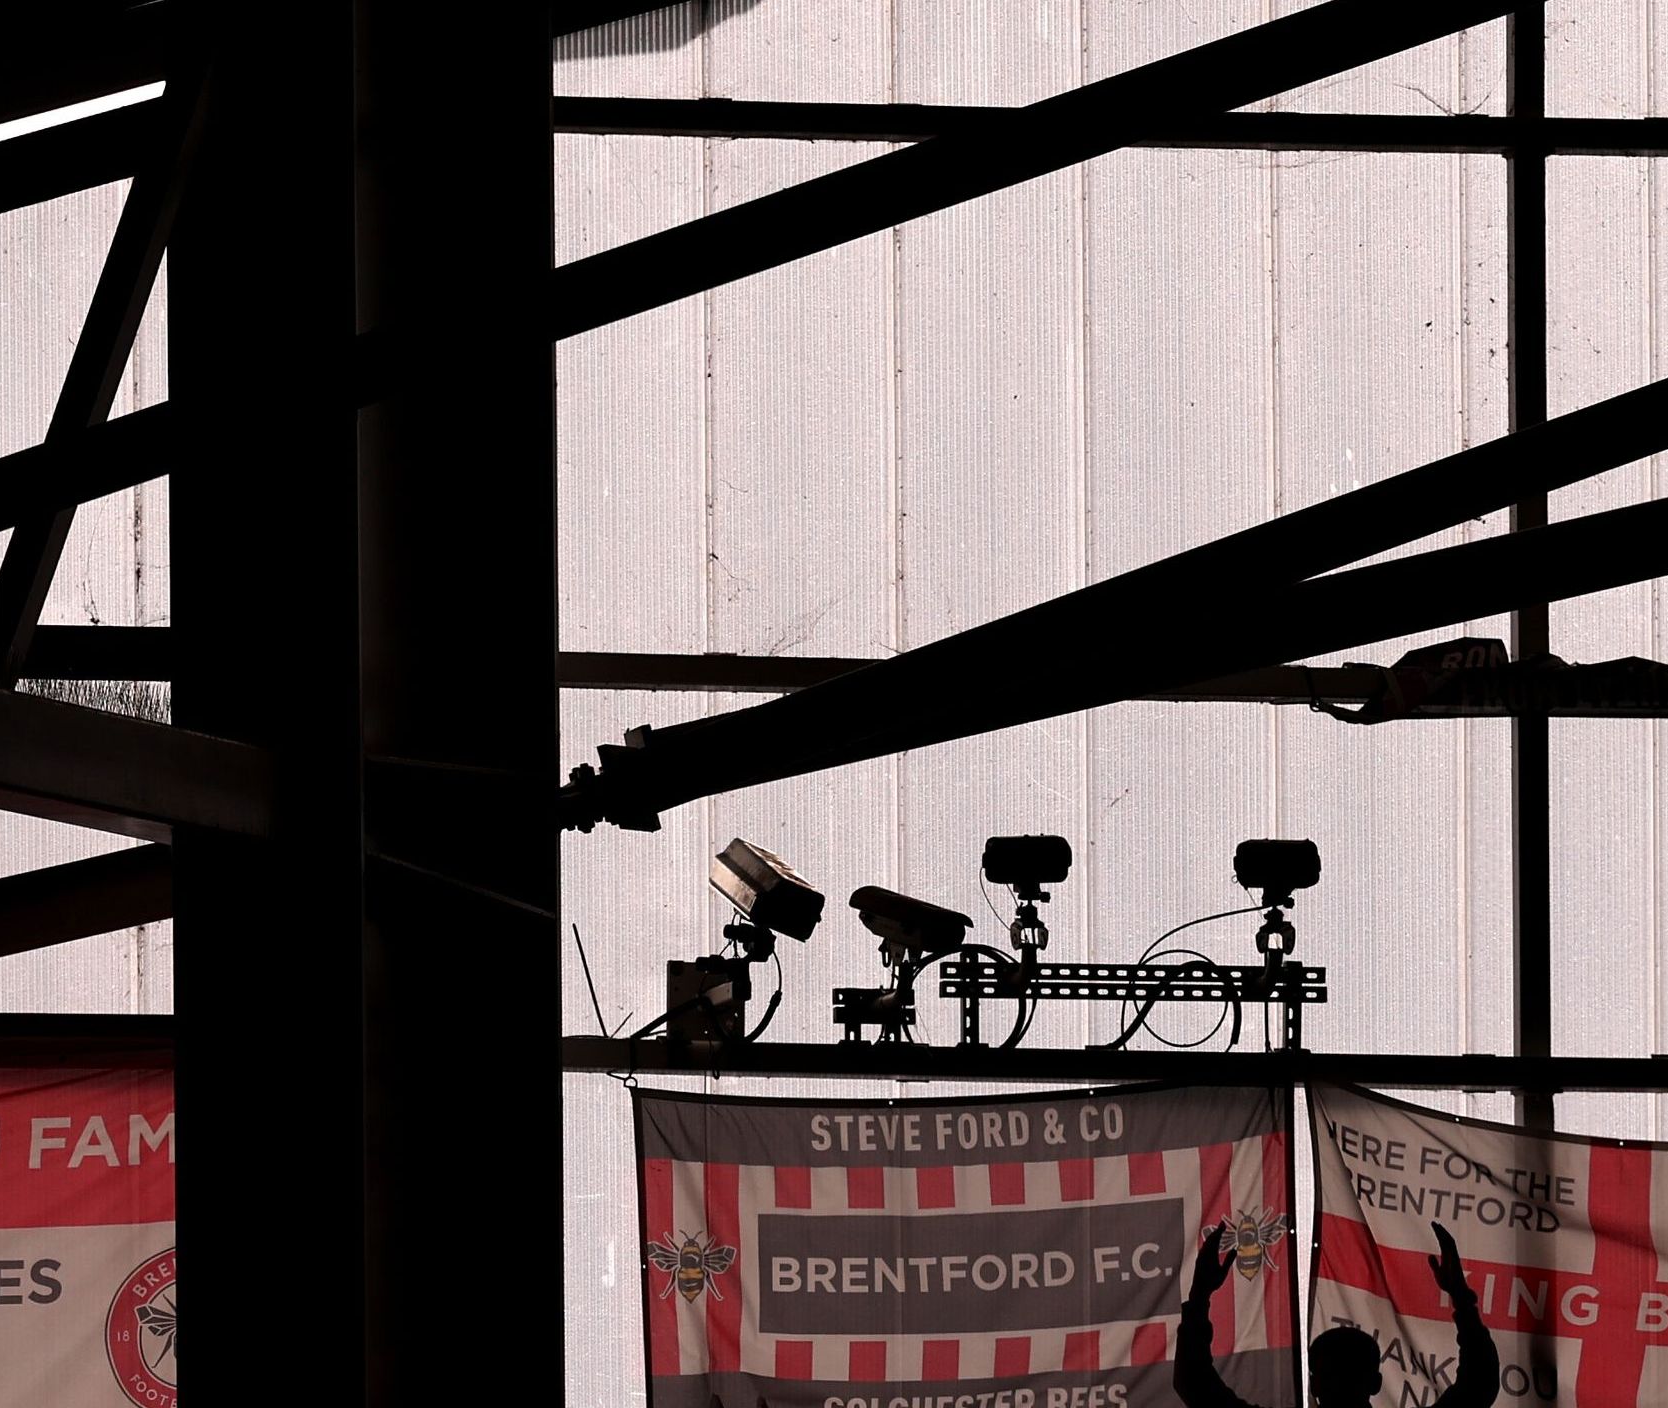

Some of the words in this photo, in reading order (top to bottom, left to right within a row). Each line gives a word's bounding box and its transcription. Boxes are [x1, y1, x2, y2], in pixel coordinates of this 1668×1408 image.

[811, 1112, 922, 1152] STEVE
[936, 1109, 1030, 1150] FORD
[1043, 1106, 1067, 1144] &
[1079, 1102, 1124, 1142] CO
[1347, 1167, 1560, 1233] RENTFORD
[1420, 1146, 1497, 1186] FOR
[1505, 1168, 1575, 1206] THE
[771, 1250, 1075, 1293] BRENTFORD
[1094, 1242, 1174, 1282] F.C.
[116, 1330, 130, 1342] 18
